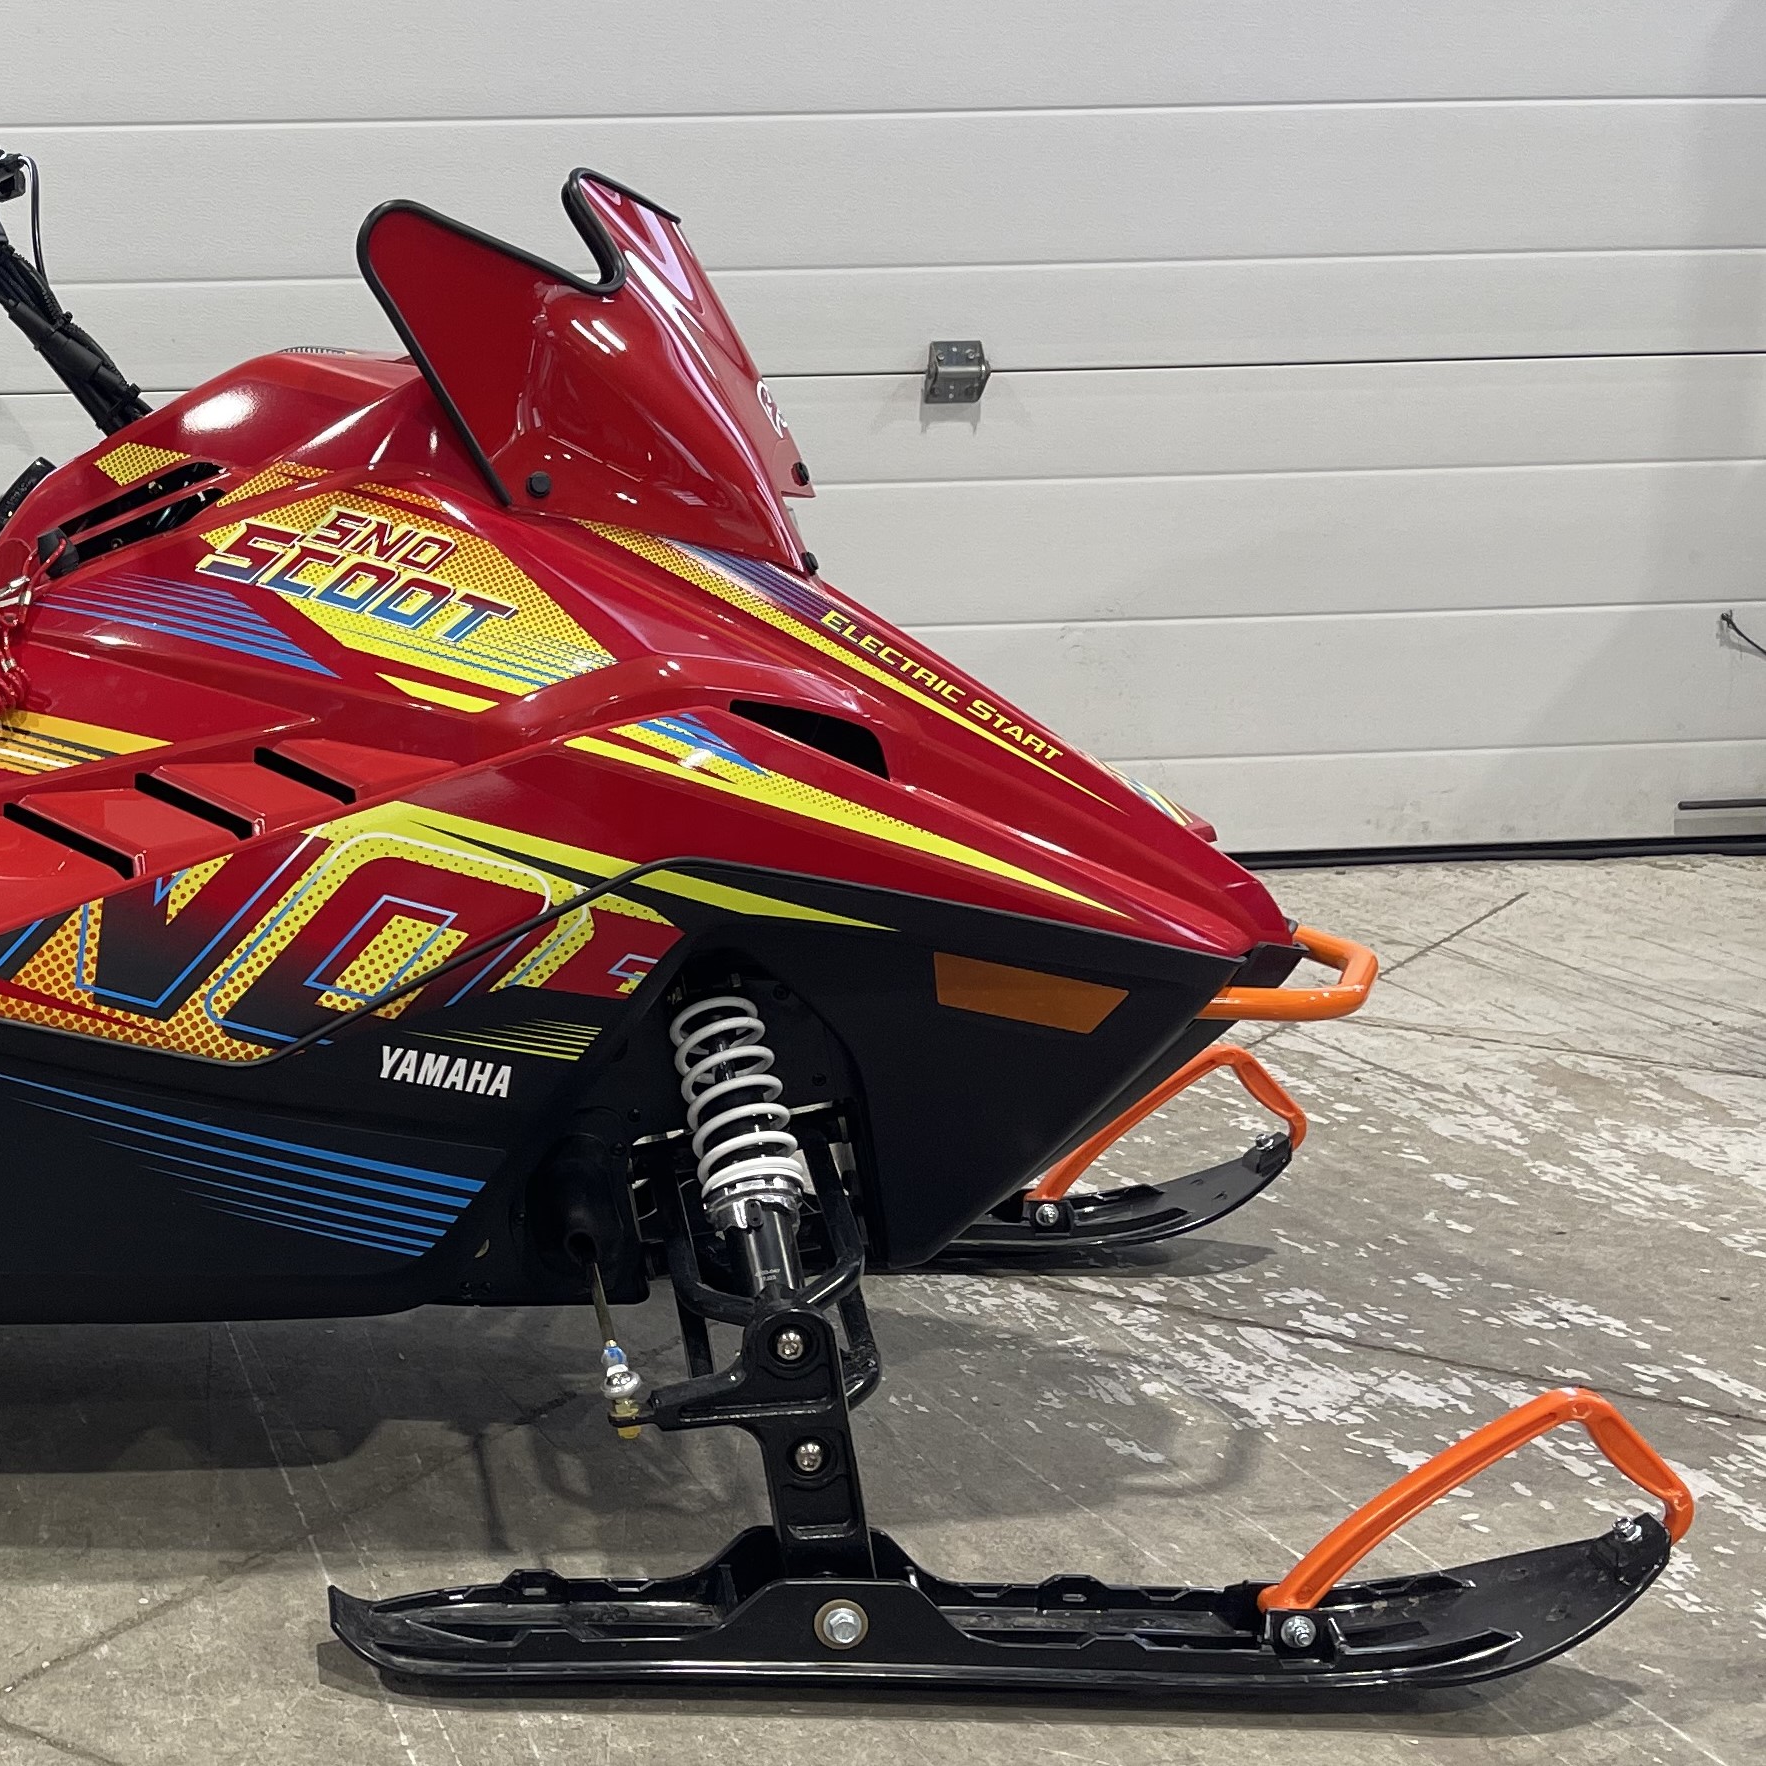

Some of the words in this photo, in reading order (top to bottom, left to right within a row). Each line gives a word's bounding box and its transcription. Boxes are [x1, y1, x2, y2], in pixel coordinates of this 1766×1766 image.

[195, 519, 518, 642] SCOOT
[298, 508, 457, 573] SNO
[820, 609, 966, 703] ELECTRIC
[966, 699, 1063, 760] START
[380, 1045, 512, 1098] YAMAHA
